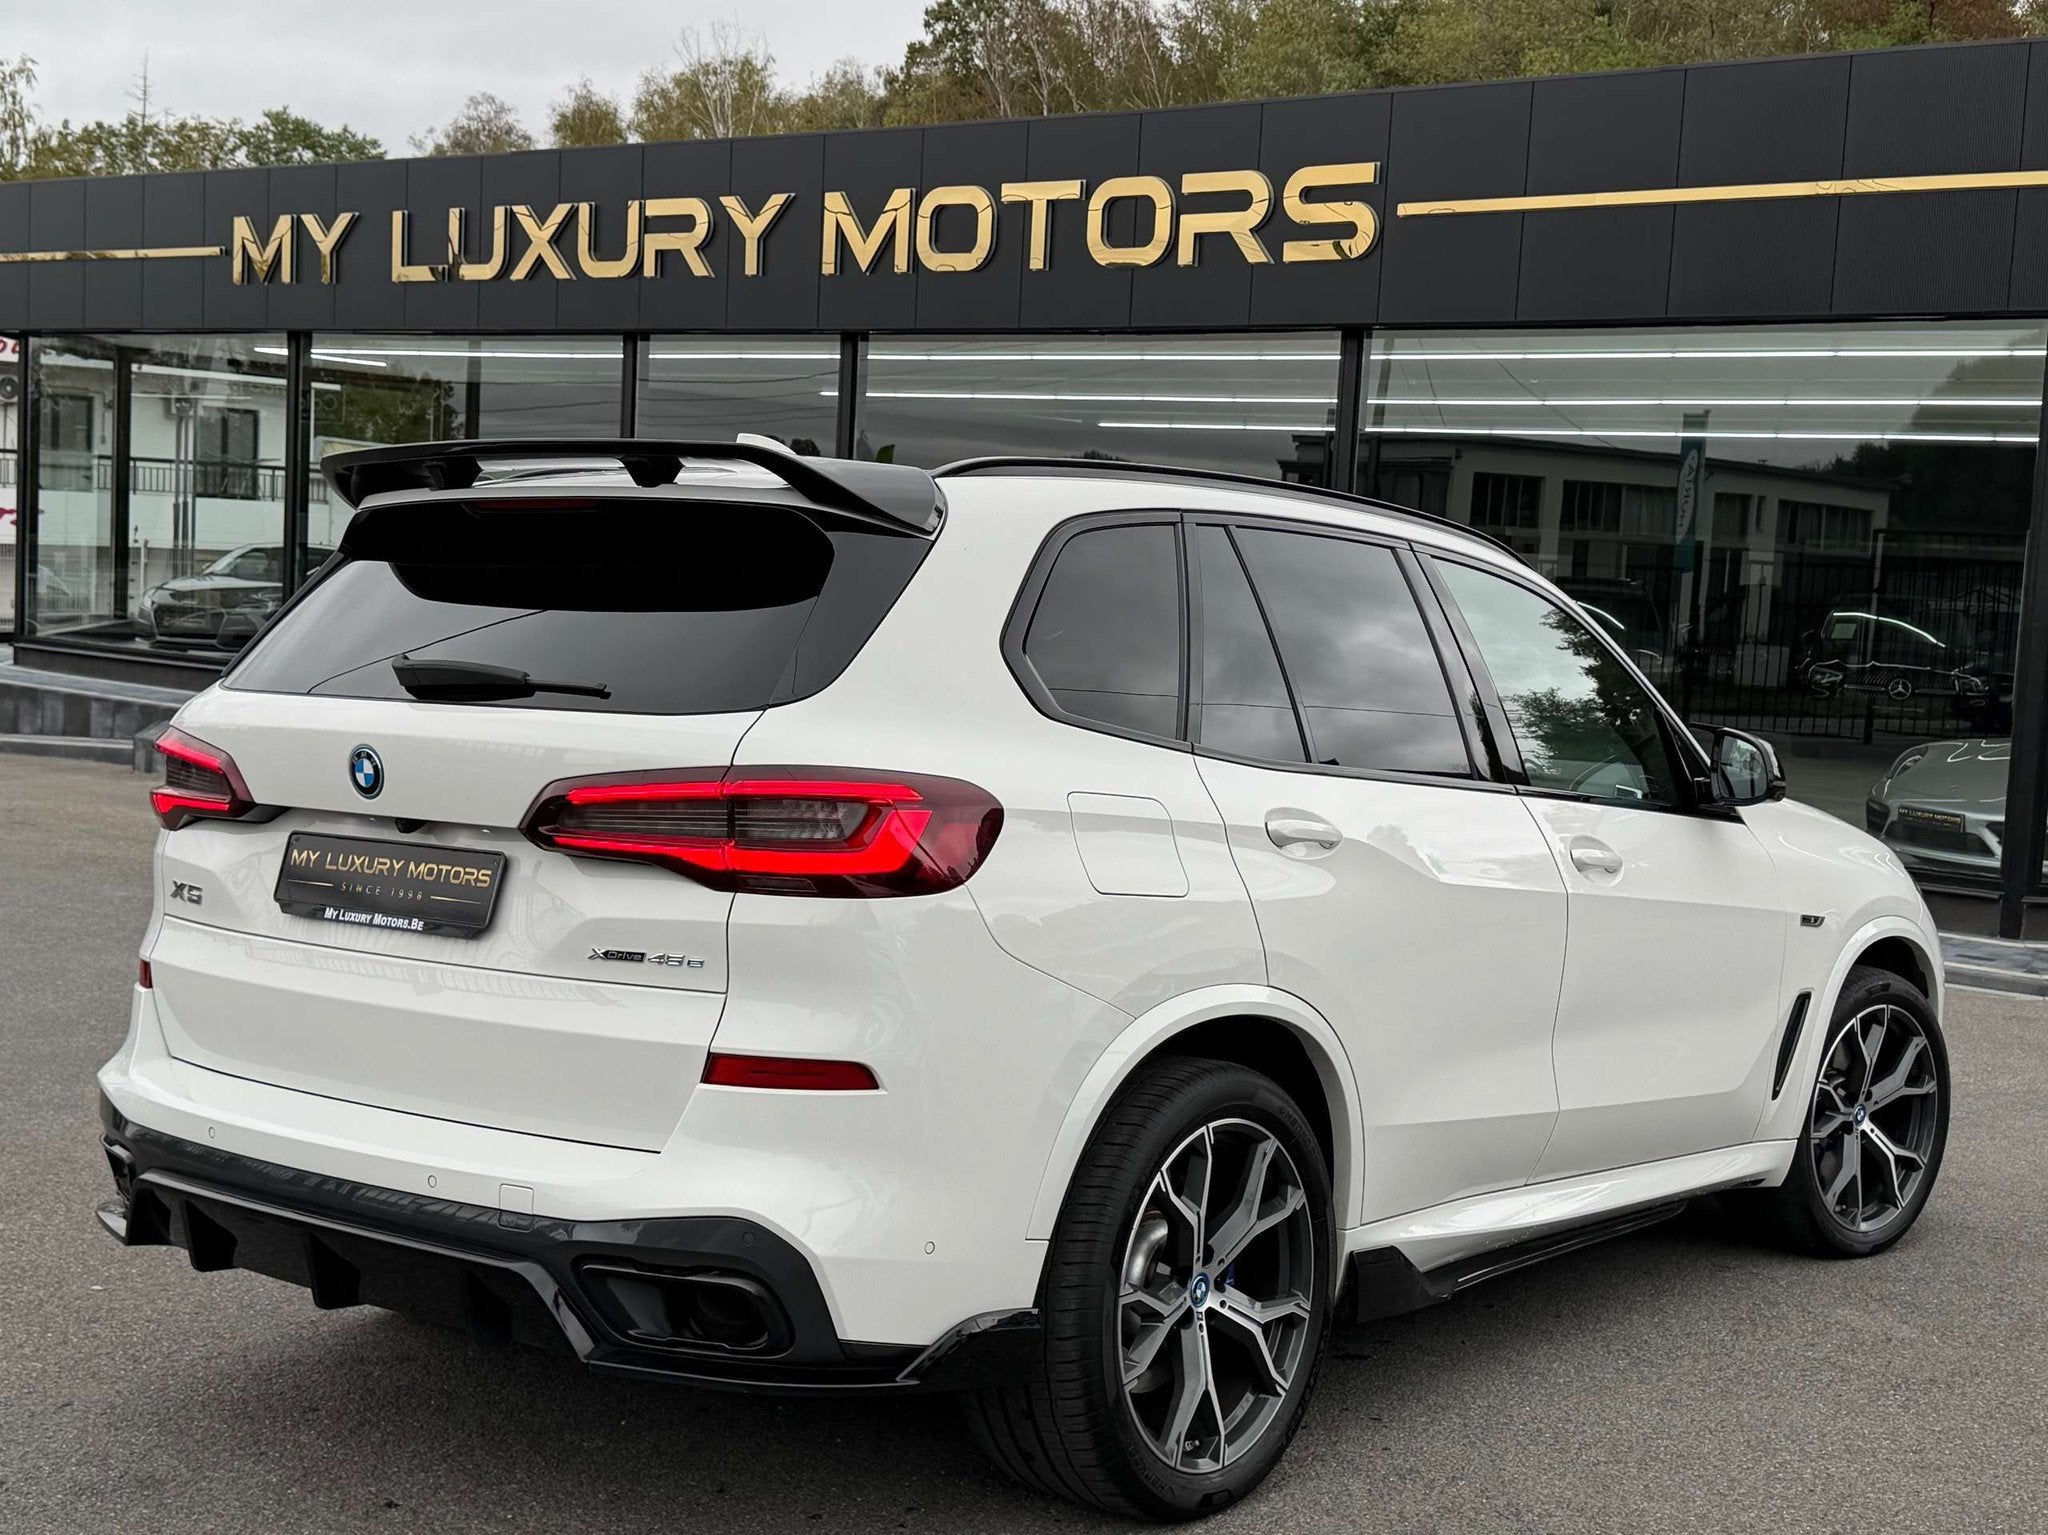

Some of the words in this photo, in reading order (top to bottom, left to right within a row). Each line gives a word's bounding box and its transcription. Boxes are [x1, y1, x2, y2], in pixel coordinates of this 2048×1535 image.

[232, 211, 359, 285] MY
[391, 192, 796, 283] LUXURY
[821, 161, 1381, 276] MOTORS
[290, 848, 321, 868] MY
[324, 851, 406, 878] LUXURY
[406, 860, 493, 888] MOTORS
[170, 880, 203, 905] X5
[340, 882, 382, 897] SINCE
[391, 889, 424, 901] 1998
